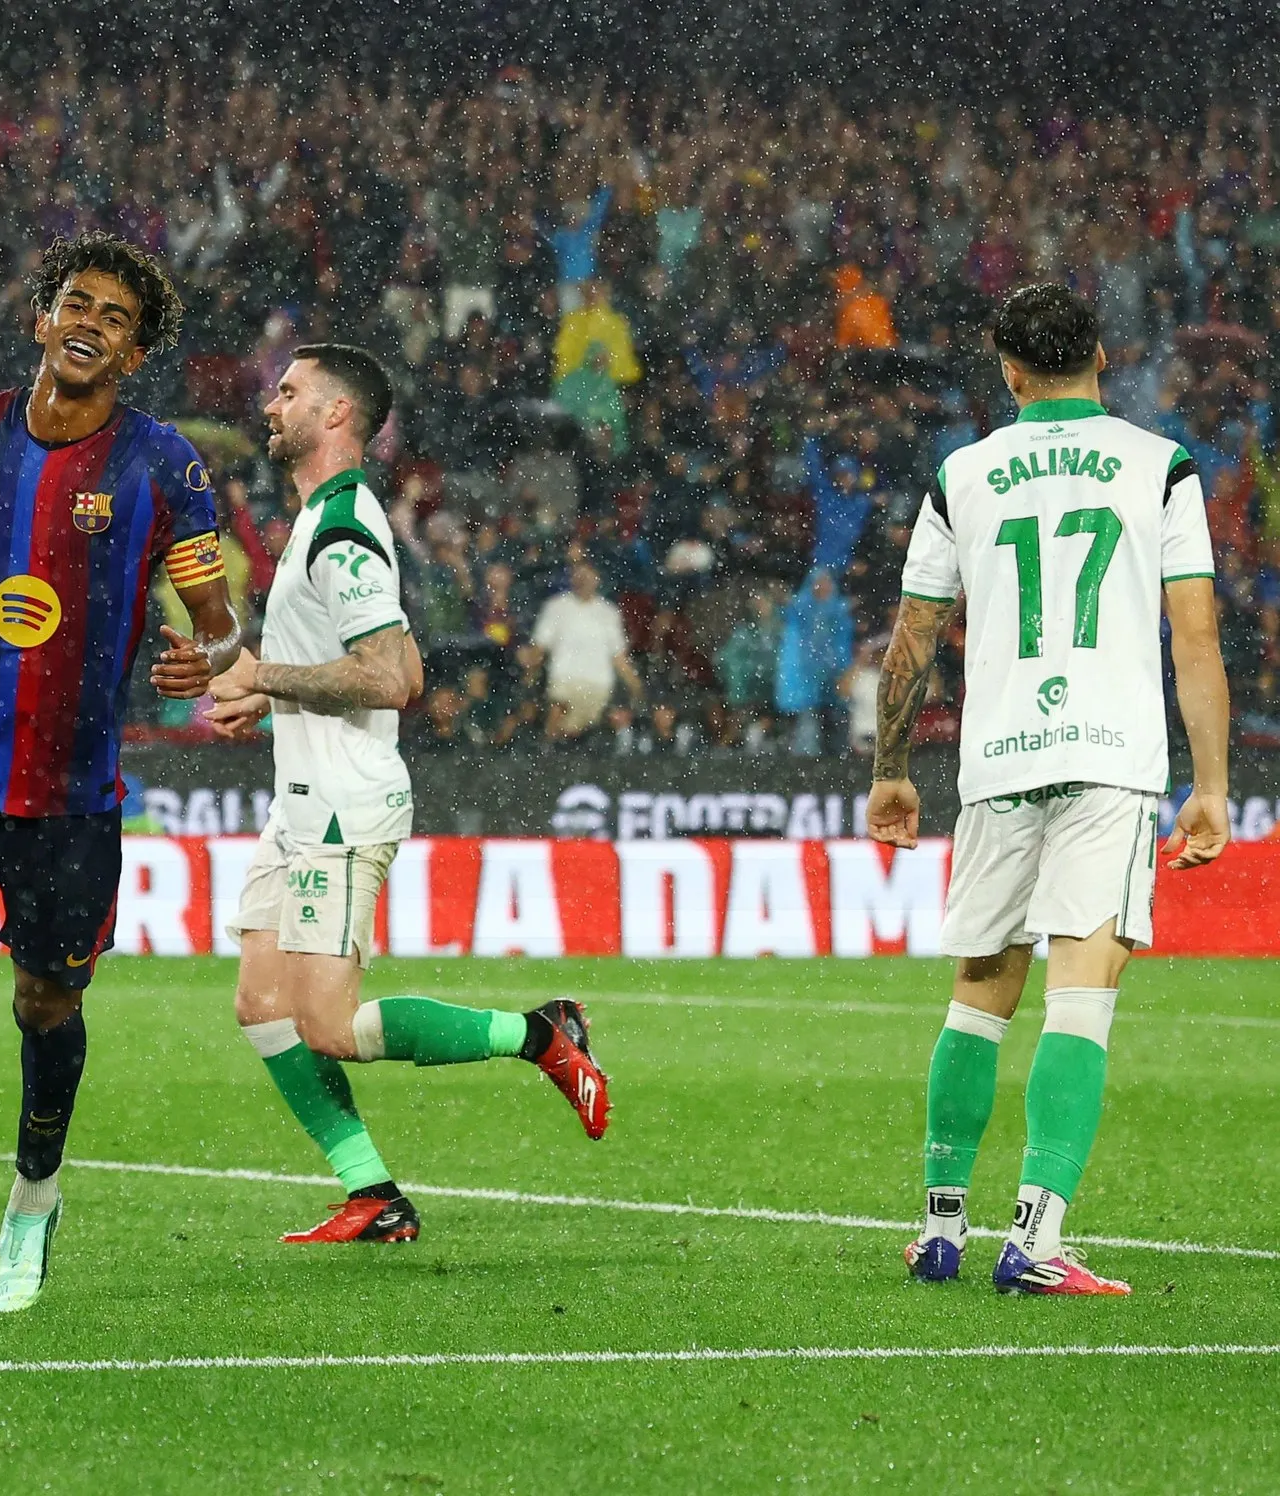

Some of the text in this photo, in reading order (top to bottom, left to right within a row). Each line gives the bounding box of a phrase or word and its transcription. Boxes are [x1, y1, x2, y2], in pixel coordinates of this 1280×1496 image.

[1029, 431, 1081, 442] Santander
[986, 447, 1123, 495] SALINAS
[338, 580, 383, 606] MGS
[995, 507, 1123, 659] 17
[983, 721, 1126, 759] cantabria labs
[385, 789, 411, 809] can
[293, 889, 328, 898] GROUP
